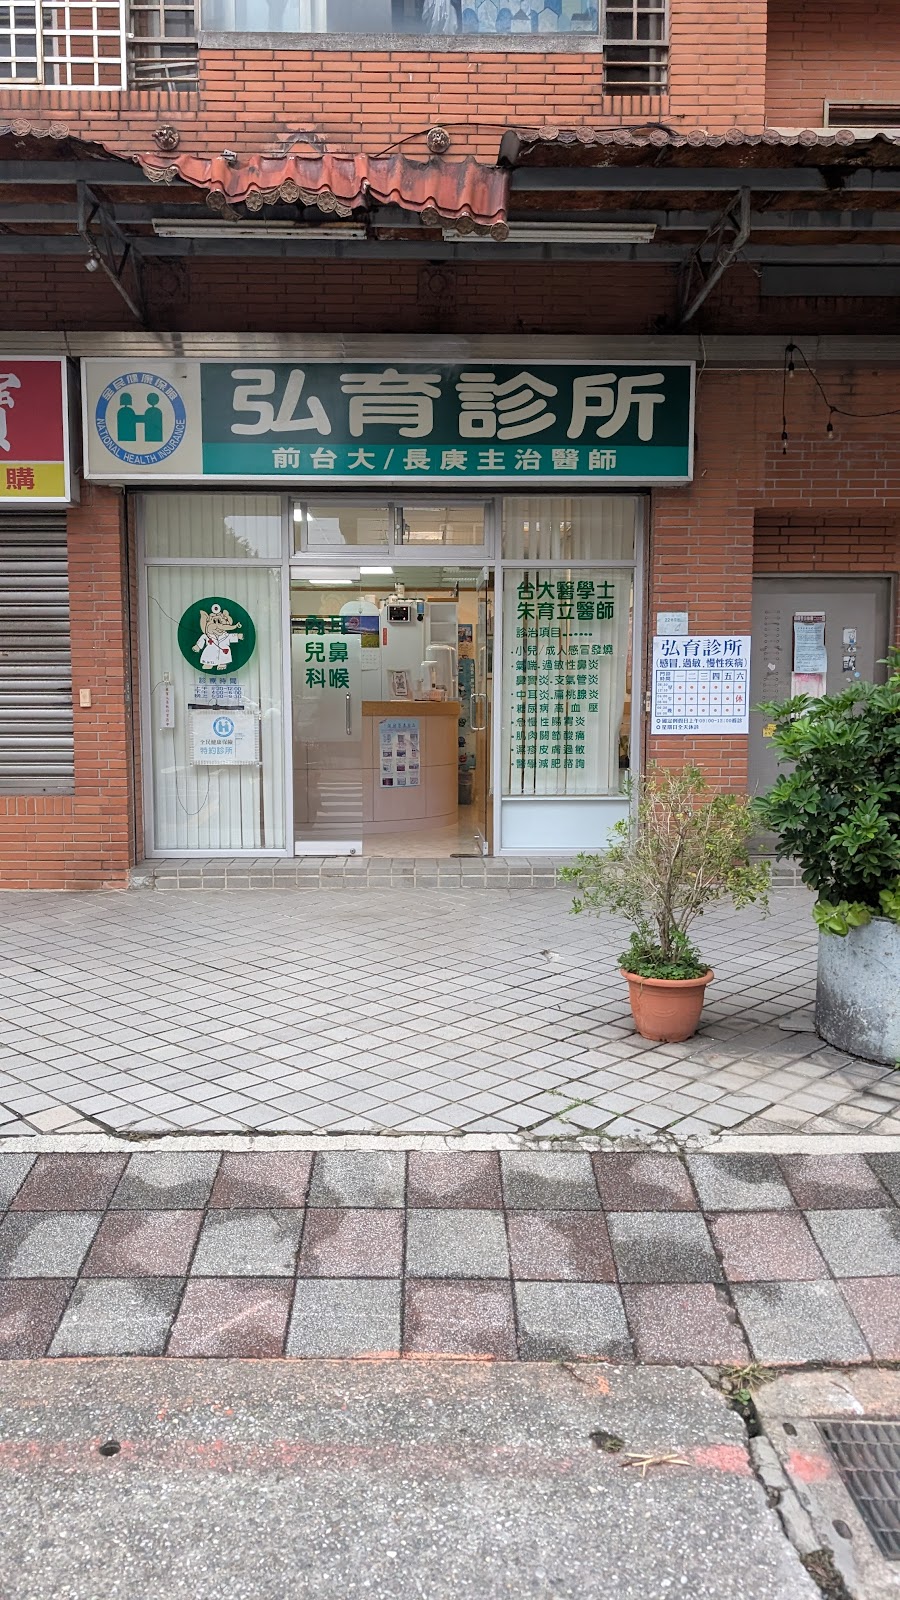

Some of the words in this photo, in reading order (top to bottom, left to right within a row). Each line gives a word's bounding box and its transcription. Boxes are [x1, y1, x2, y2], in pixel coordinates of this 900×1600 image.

[231, 368, 666, 442] 弘育診所
[96, 418, 121, 458] NATIONAL
[123, 453, 158, 465] HEALTH
[157, 419, 185, 460] INSURANCE
[272, 447, 618, 471] 前台大/長庚主治醫師
[516, 581, 615, 600] 台大醫學士
[516, 601, 615, 620] 朱育立醫師
[661, 639, 742, 656] 弘育診所
[713, 672, 720, 680] 四
[725, 672, 732, 680] 五
[736, 672, 744, 680] 六
